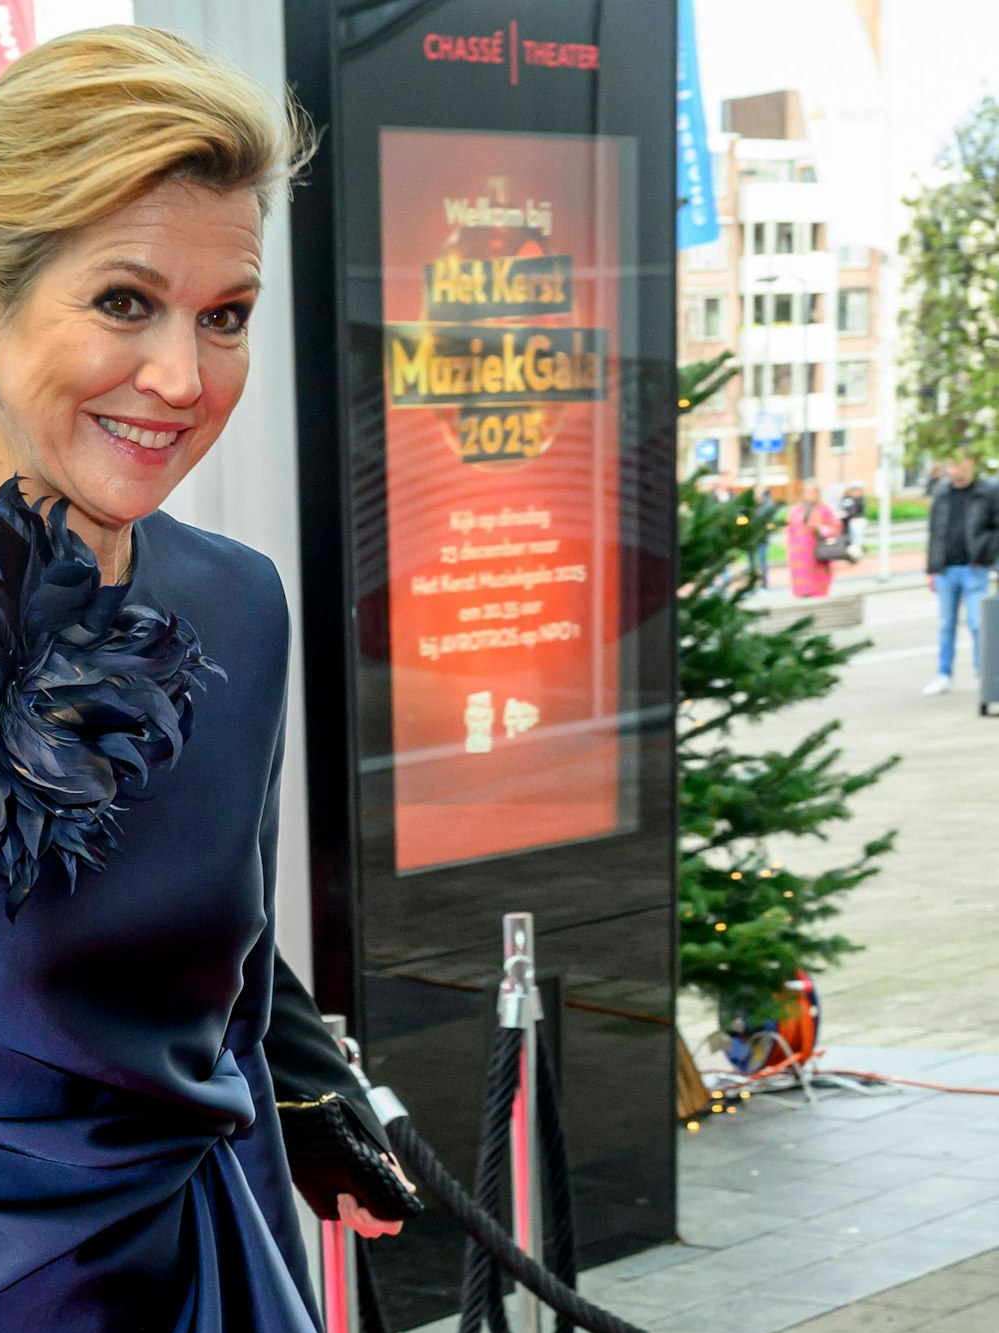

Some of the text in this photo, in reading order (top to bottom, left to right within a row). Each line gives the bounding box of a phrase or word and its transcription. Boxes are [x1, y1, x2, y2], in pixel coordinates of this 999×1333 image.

[423, 29, 599, 69] CHASSÉ THEATER
[443, 197, 552, 235] Welkom bij
[431, 257, 565, 304] Het Kerst
[391, 330, 600, 396] MuziekGala
[459, 412, 543, 457] 2025
[460, 538, 525, 561] december
